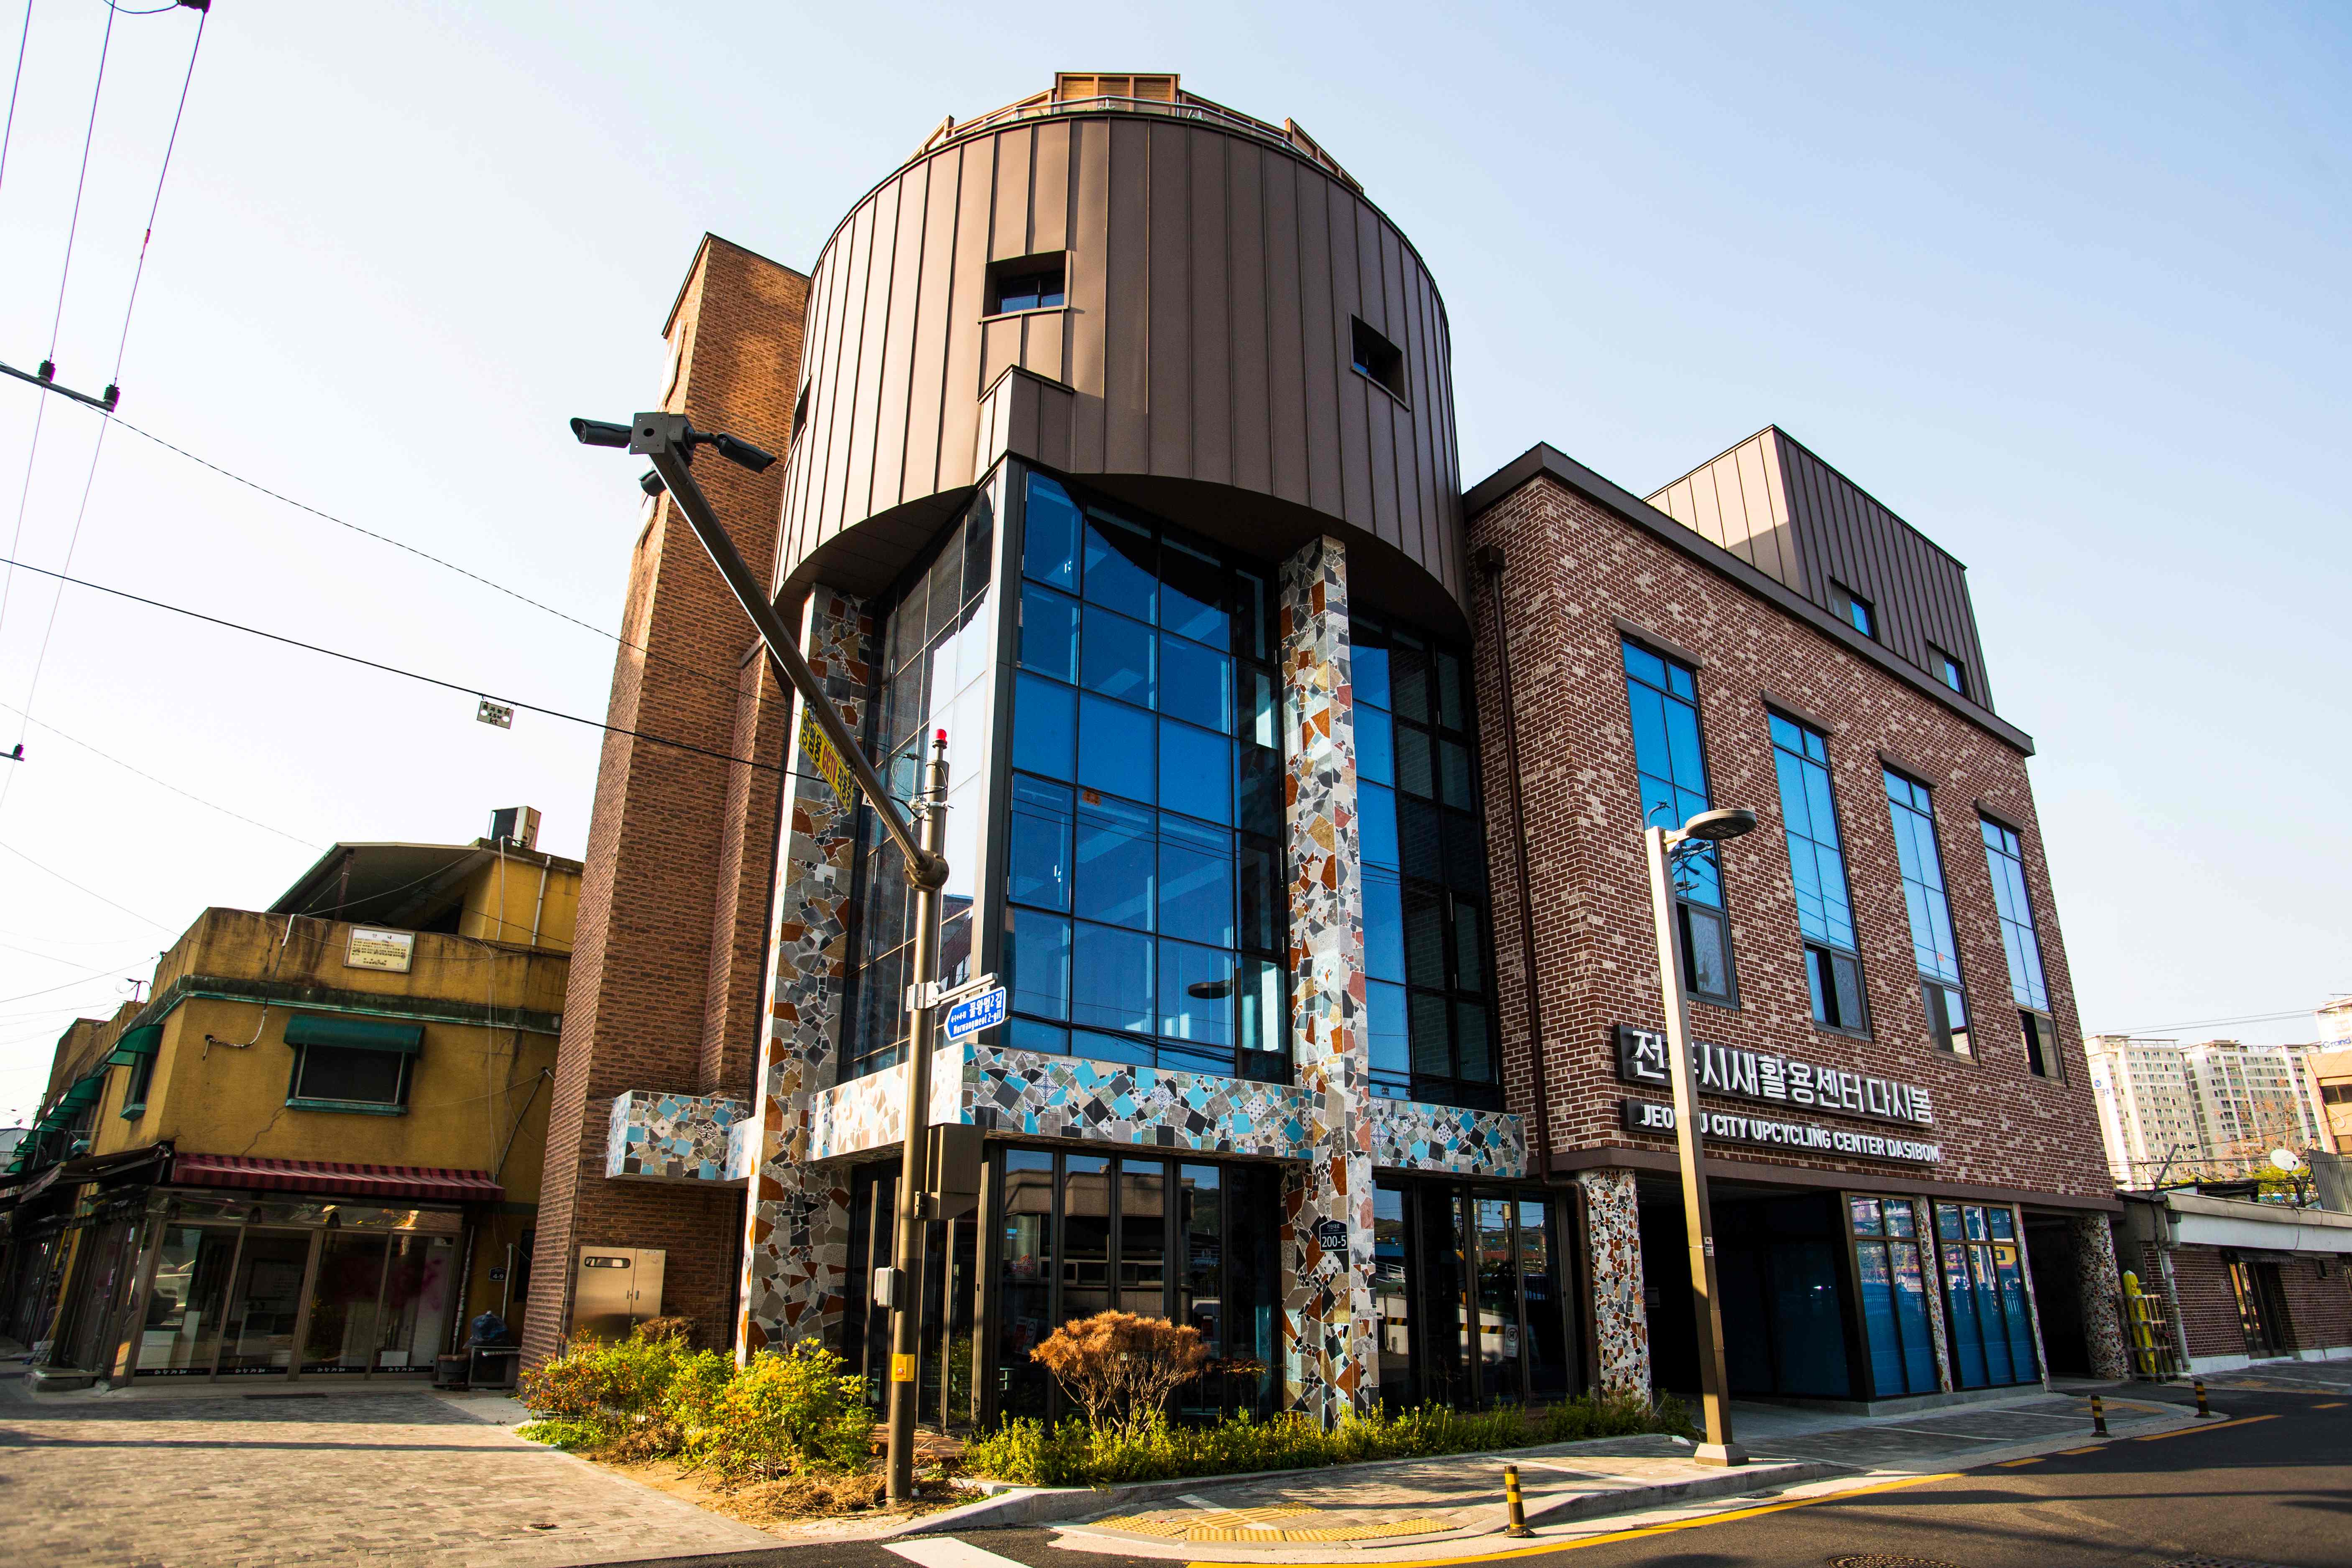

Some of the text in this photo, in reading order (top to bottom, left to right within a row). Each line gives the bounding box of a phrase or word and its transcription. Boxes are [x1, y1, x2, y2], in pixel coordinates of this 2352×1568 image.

[822, 746, 838, 784] CCTV
[988, 1009, 1001, 1023] 2-gil
[1866, 1078, 1933, 1124] 다시봄
[1641, 1104, 1940, 1163] JEOU CITY UPCYCLING CENTER DASIBOM
[1322, 1235, 1346, 1247] 200-5
